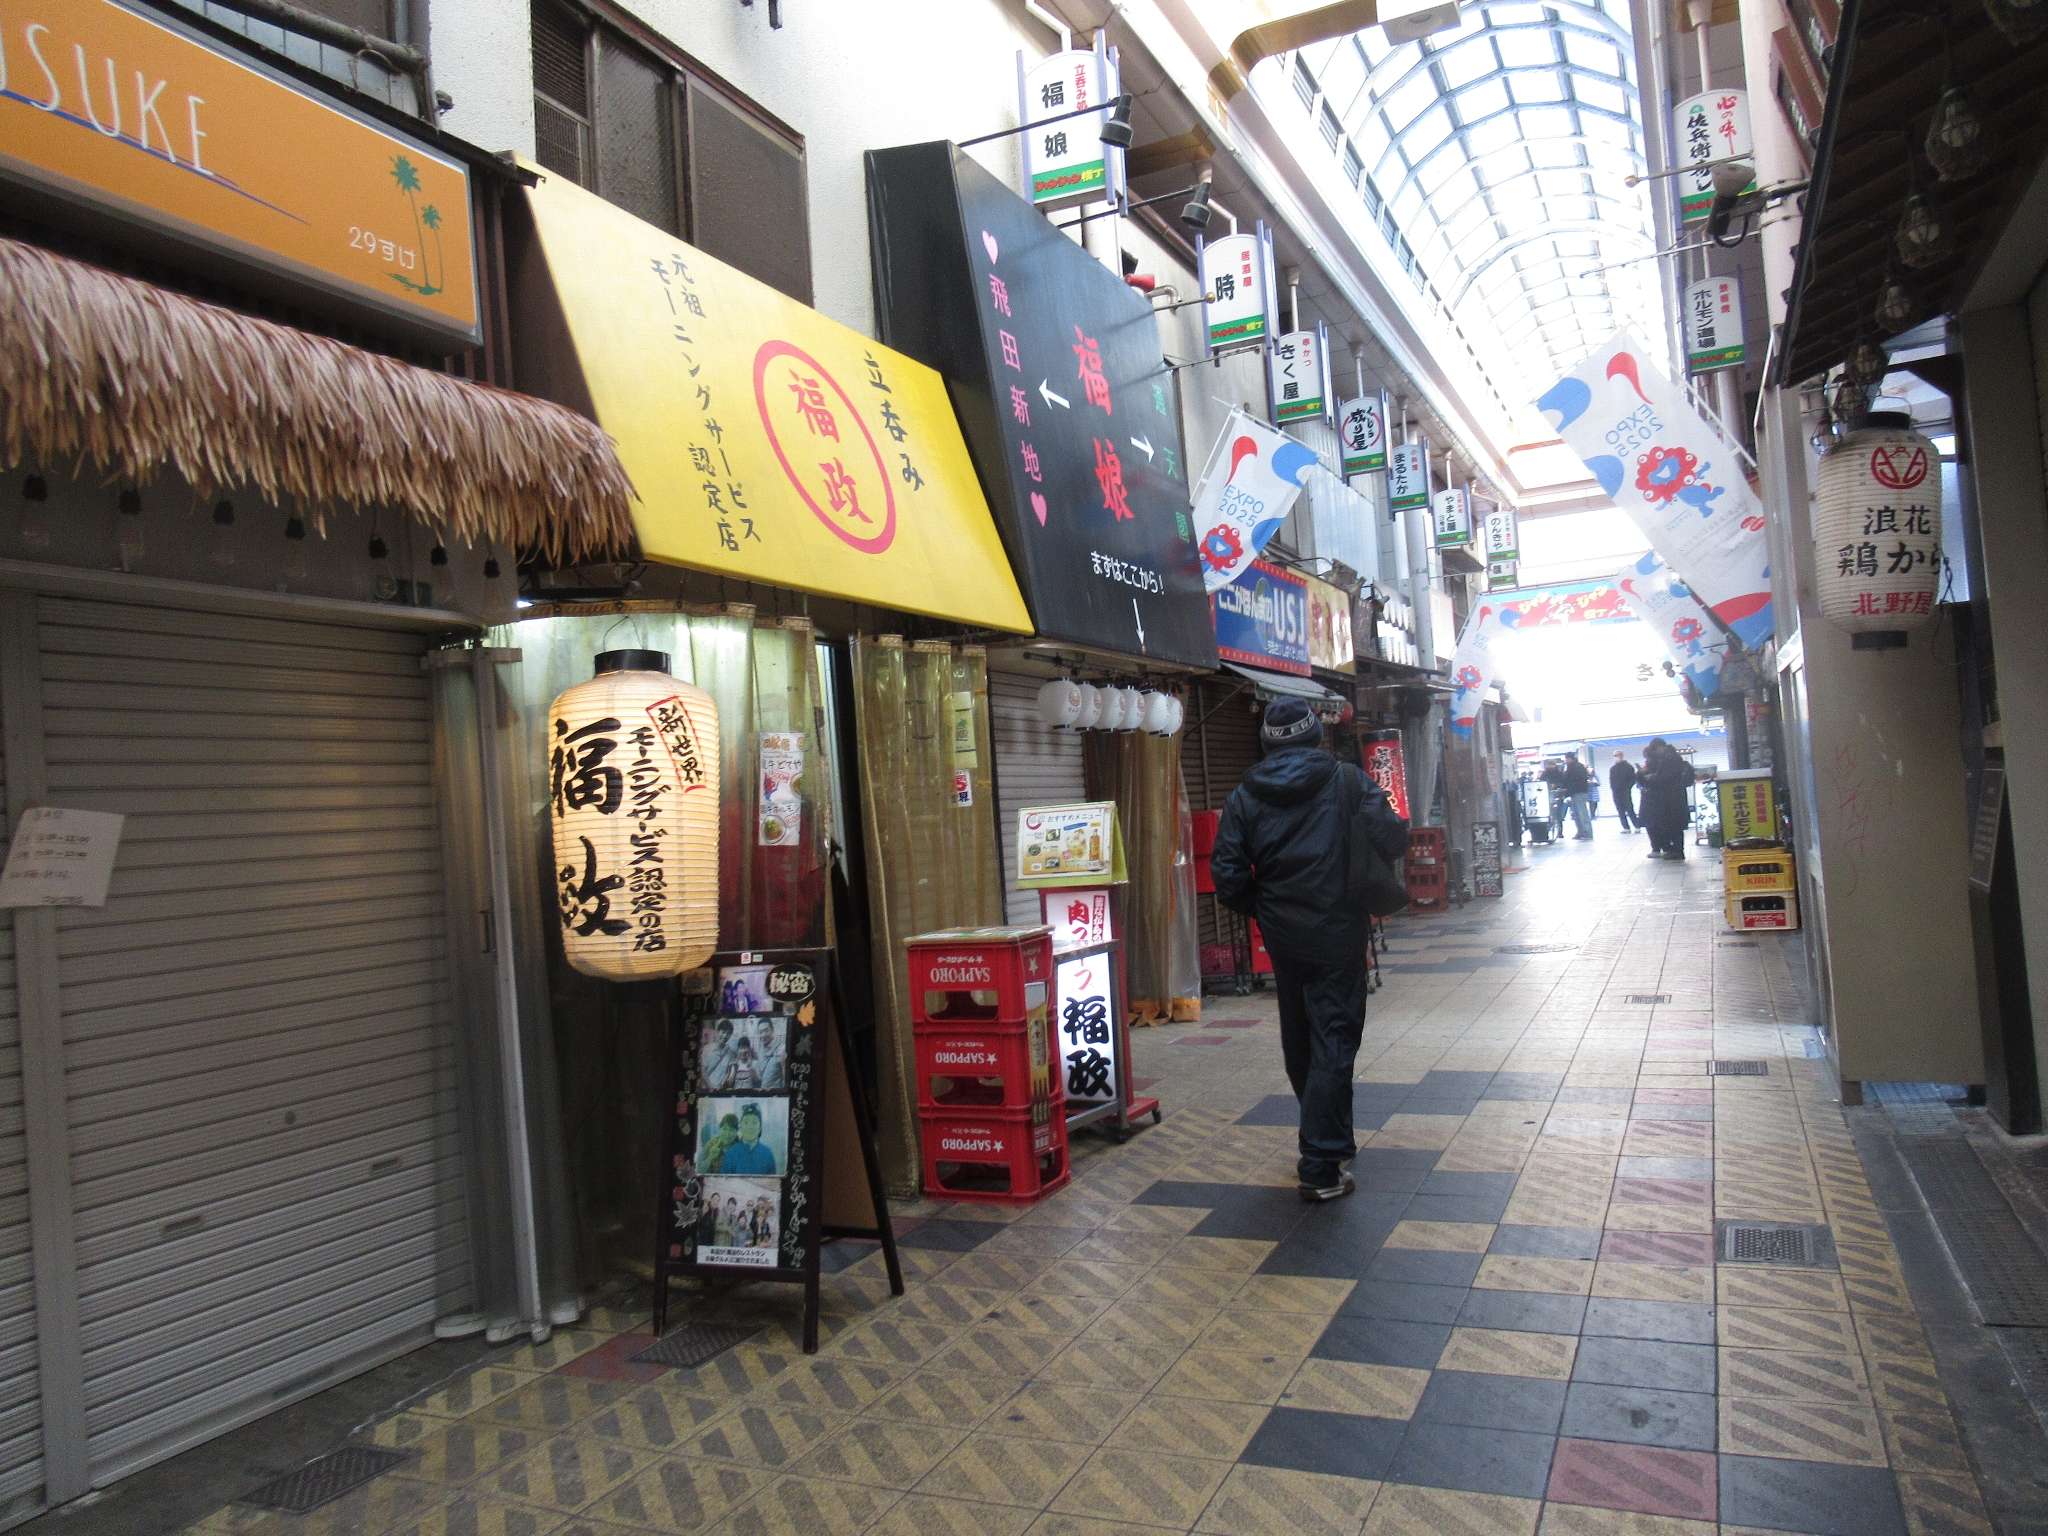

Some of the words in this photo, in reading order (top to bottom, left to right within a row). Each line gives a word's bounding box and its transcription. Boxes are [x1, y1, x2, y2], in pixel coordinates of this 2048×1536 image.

[0, 12, 214, 176] SUKE
[1041, 81, 1068, 159] 福娘
[349, 226, 416, 270] 29すけ
[671, 253, 706, 319] 元祖
[1215, 273, 1235, 302] 時
[650, 258, 762, 543] モーニングサービス
[988, 272, 1044, 483] 飛田新地
[1280, 344, 1300, 401] きく屋
[788, 367, 875, 525] 福政
[863, 349, 926, 492] 立呑み
[1072, 324, 1135, 523] 福娘
[688, 442, 741, 552] 認定店
[1224, 484, 1264, 514] EXPO
[1394, 453, 1408, 495] まるたか
[1218, 498, 1257, 528] 2025
[1863, 505, 1932, 536] 浪花
[1852, 591, 1934, 616] 北野屋
[656, 704, 704, 785] 新世界
[930, 967, 991, 984] SAPPORO
[936, 1051, 986, 1064] SAPPORO
[1063, 995, 1115, 1099] 福政
[942, 1137, 992, 1151] SAPPORO
